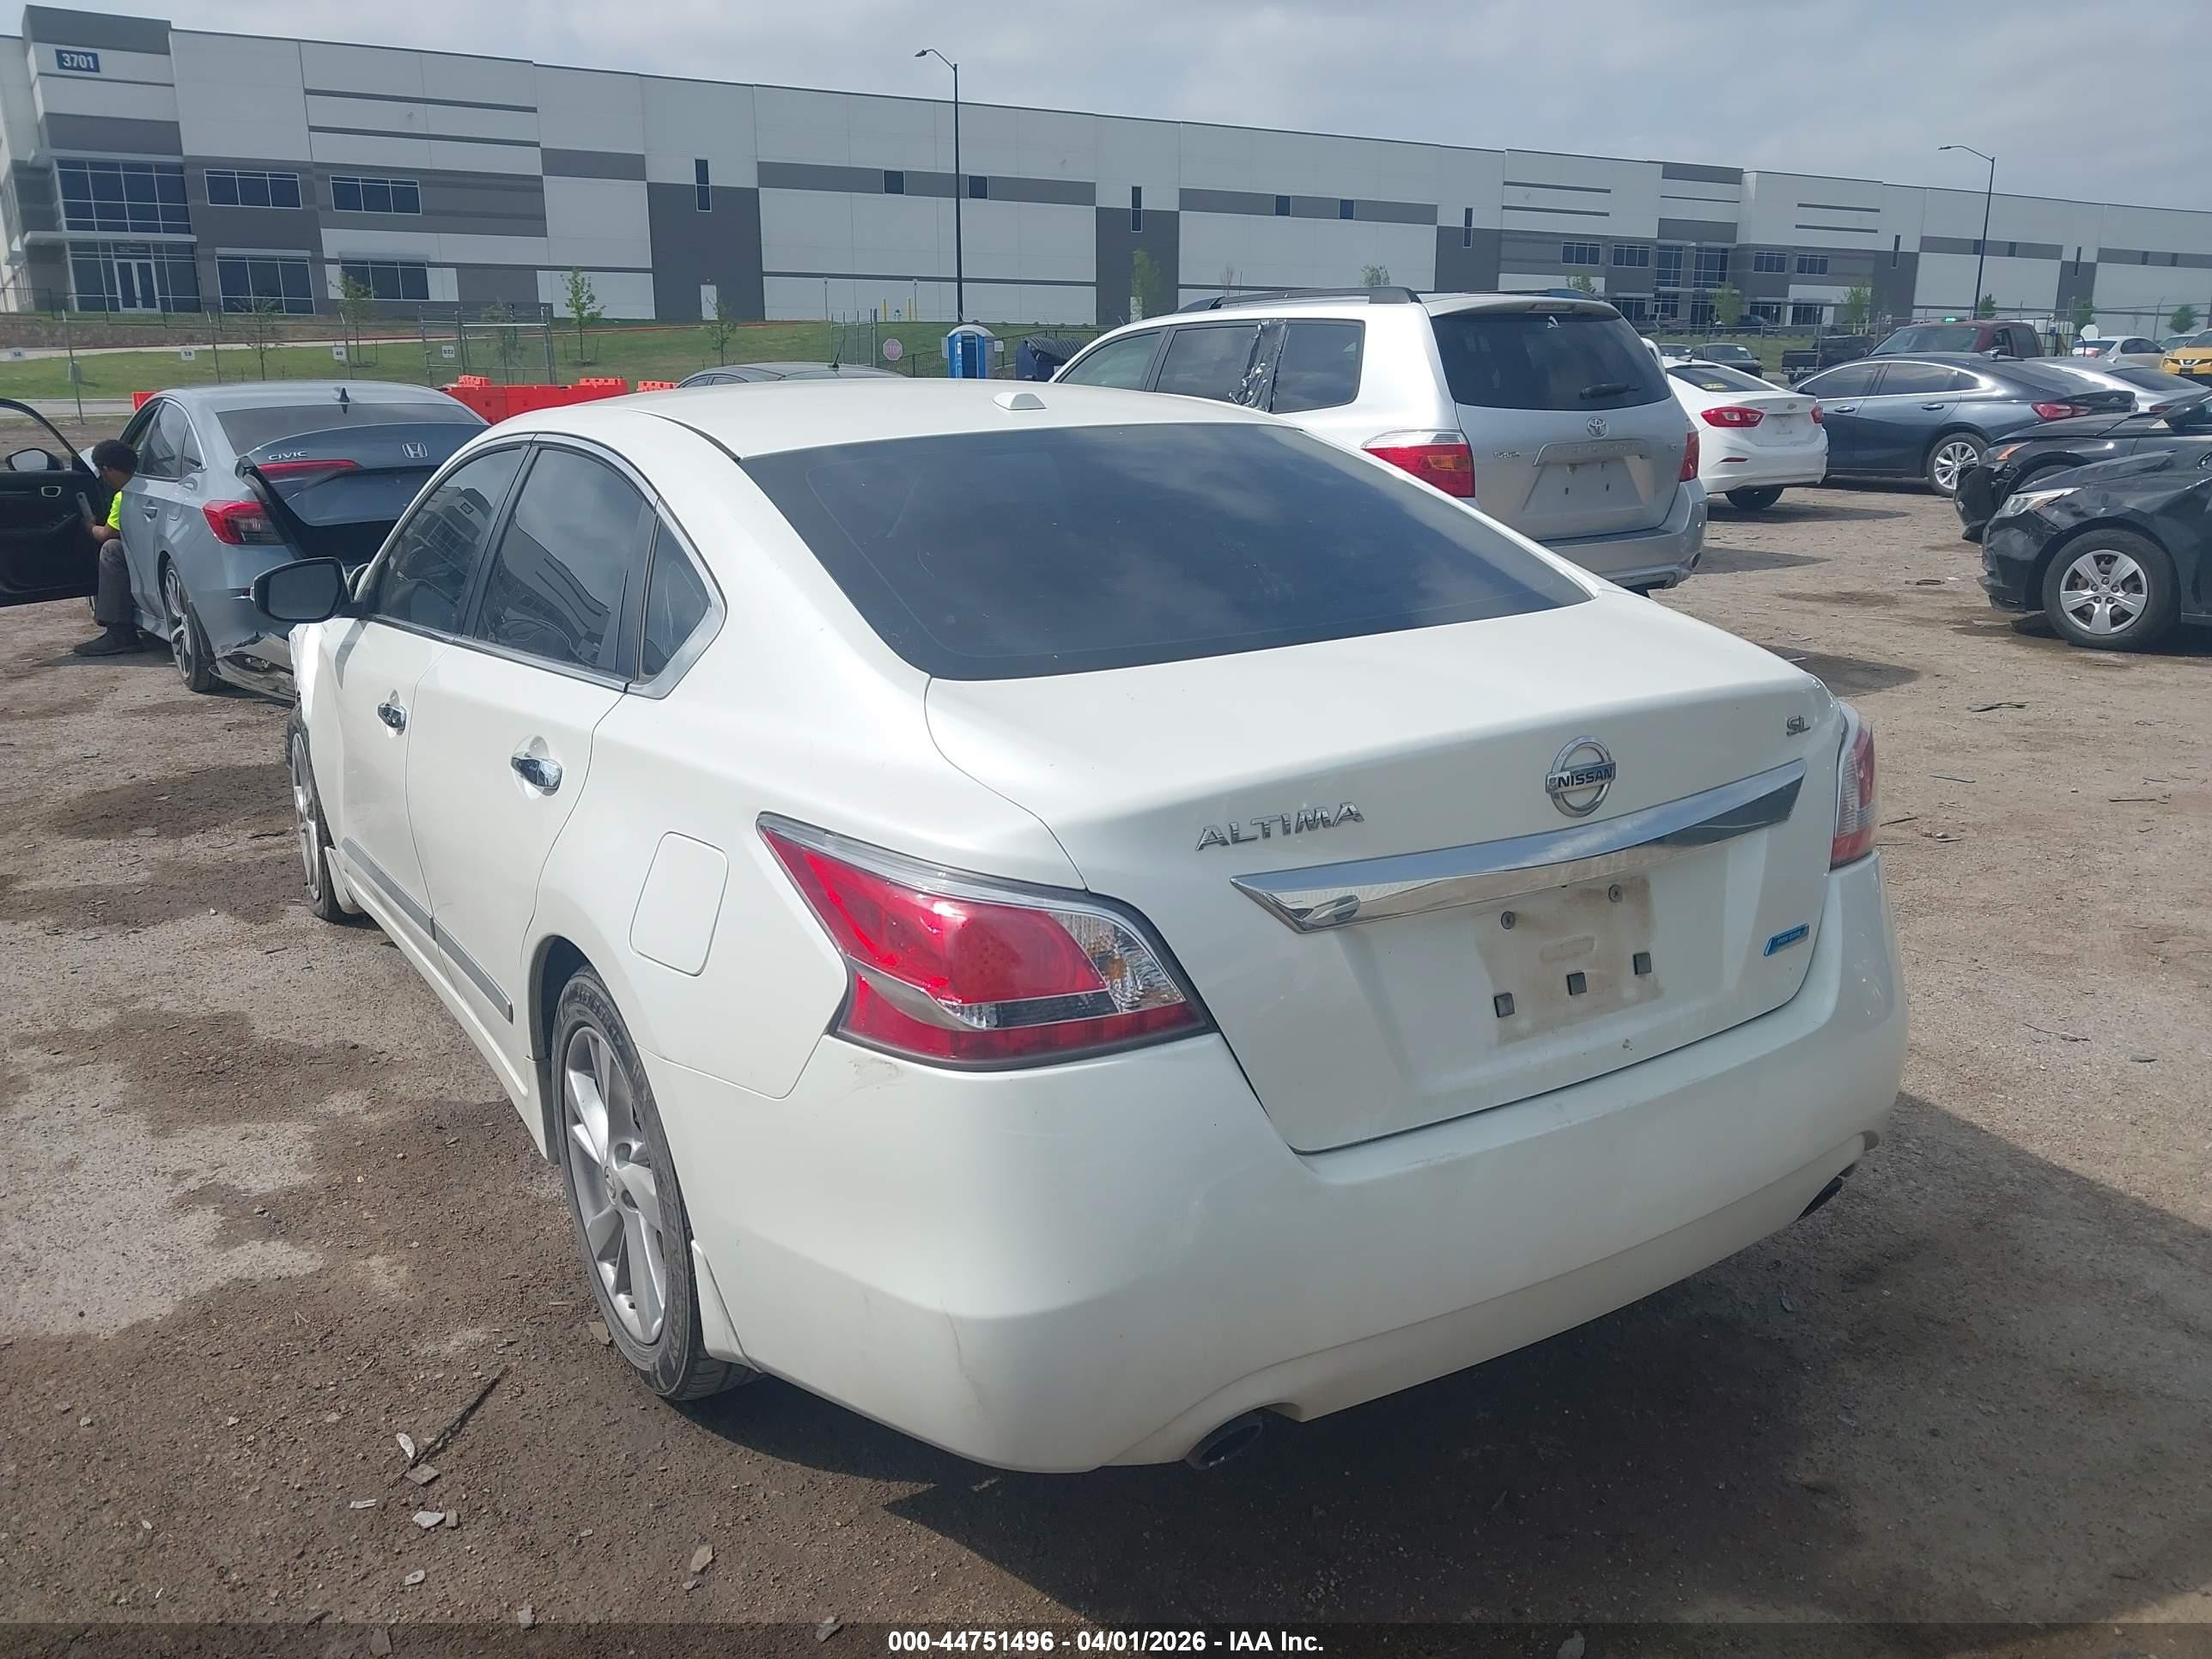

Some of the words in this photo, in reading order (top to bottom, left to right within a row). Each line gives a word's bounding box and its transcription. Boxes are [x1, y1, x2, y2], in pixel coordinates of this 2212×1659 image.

[62, 53, 94, 69] 3701
[268, 451, 307, 461] CIVIC
[1786, 714, 1811, 736] SL
[1558, 766, 1613, 788] NISSAN
[1195, 801, 1365, 851] ALTIMA
